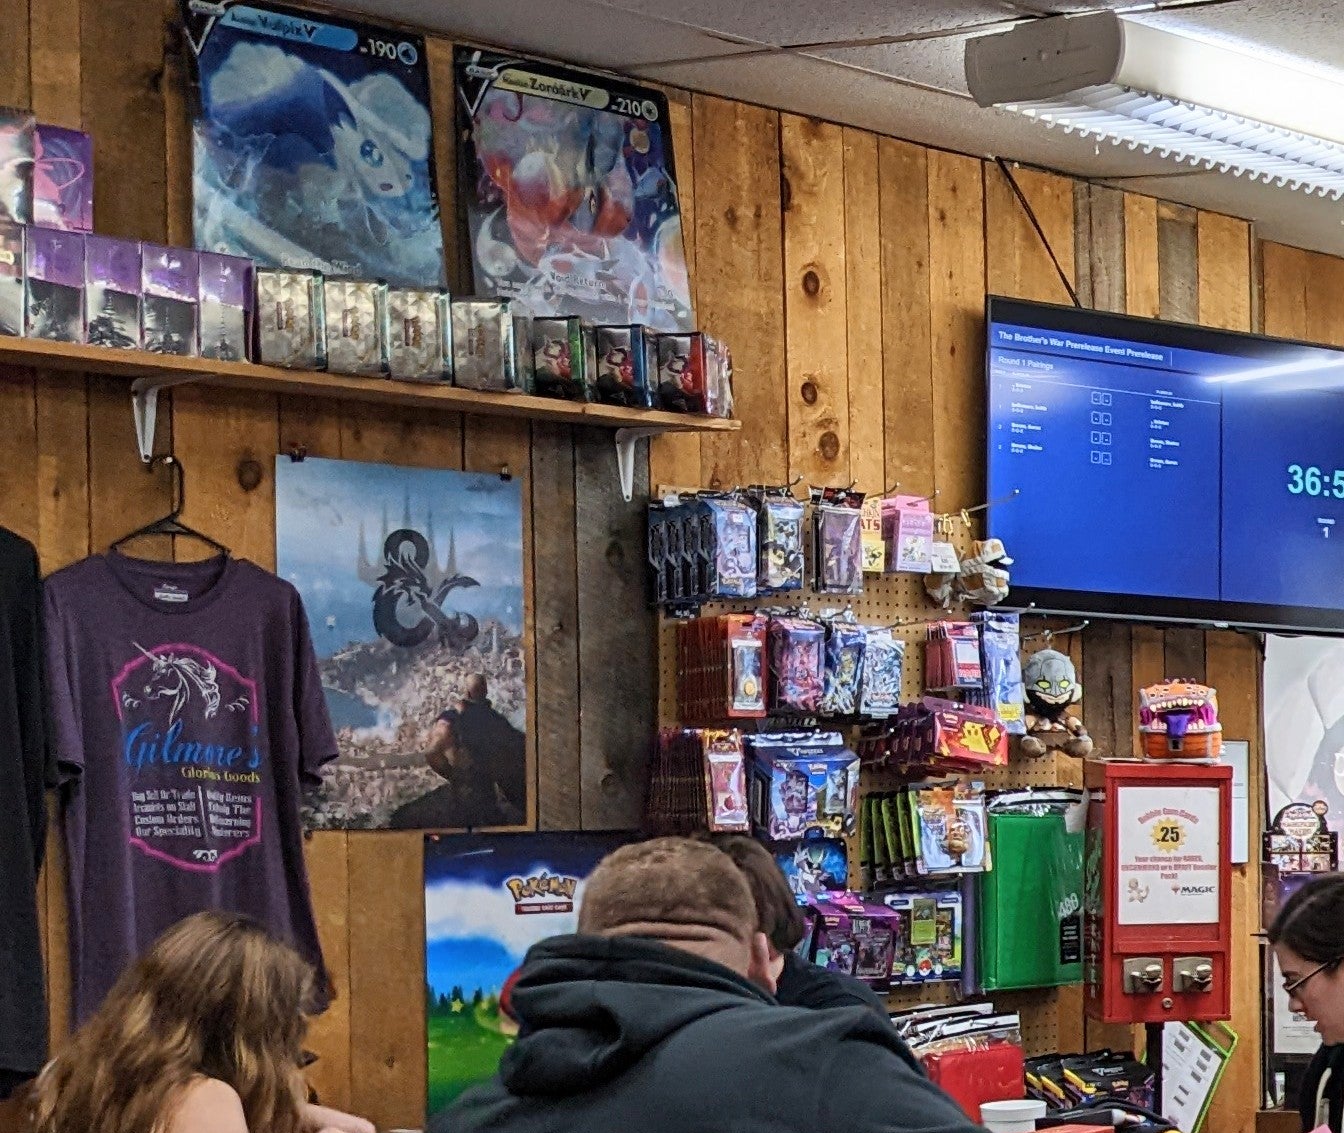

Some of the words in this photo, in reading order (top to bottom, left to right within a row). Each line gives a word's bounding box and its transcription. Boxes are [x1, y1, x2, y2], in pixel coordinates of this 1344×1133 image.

[367, 38, 397, 60] 190
[617, 97, 642, 116] 210
[999, 331, 1013, 341] The
[1014, 333, 1048, 346] Brother's
[1050, 338, 1065, 348] War
[1065, 340, 1104, 353] Prerelease
[1105, 345, 1125, 356] Event
[1126, 349, 1164, 361] Prerelease
[999, 356, 1020, 366] Round
[1028, 360, 1054, 371] Pairings
[1322, 526, 1330, 539] 1
[1156, 826, 1180, 843] .25
[506, 872, 578, 902] Pokémon
[1180, 886, 1216, 894] MAGIC
